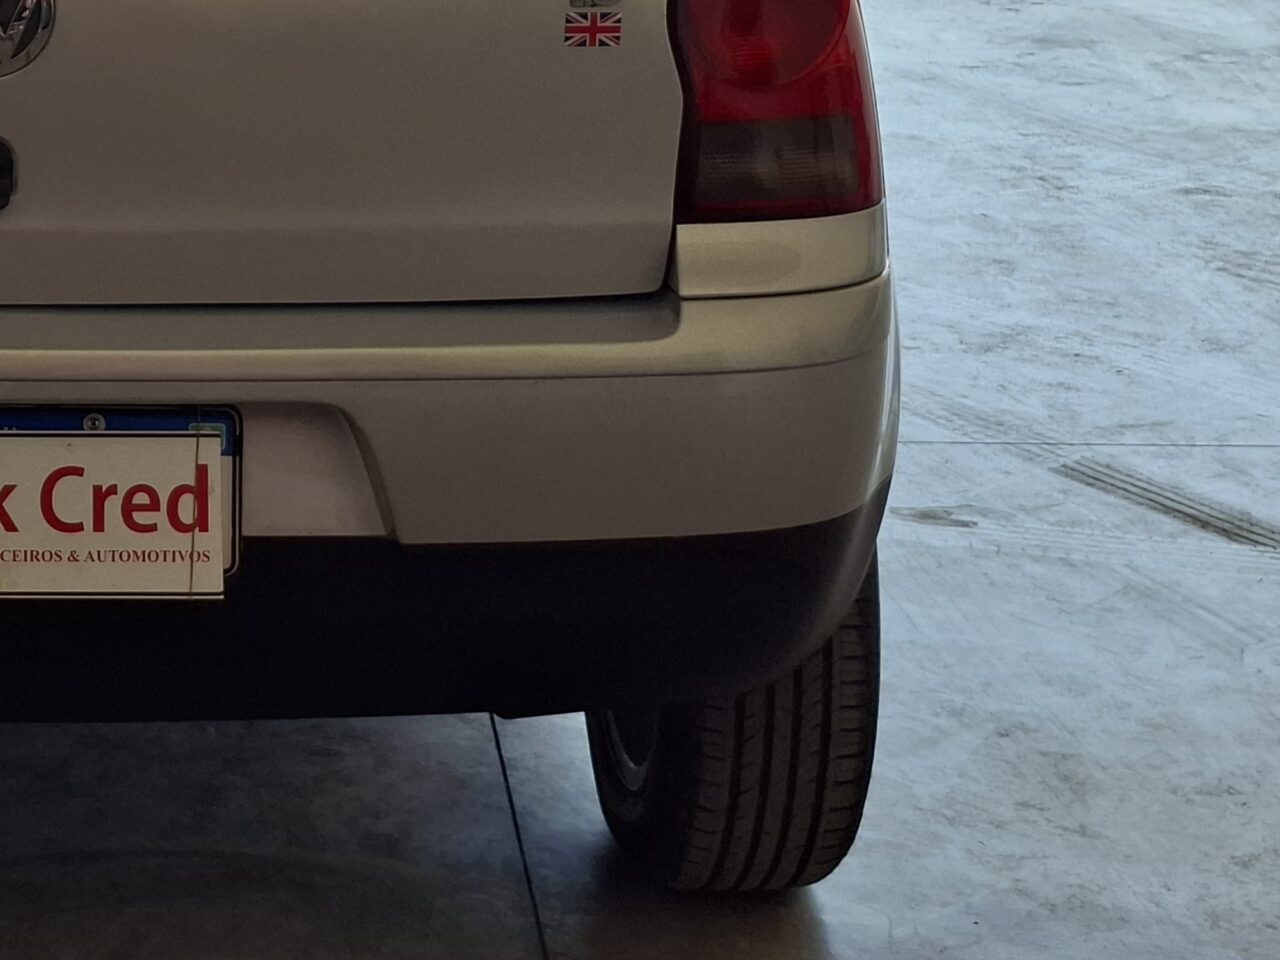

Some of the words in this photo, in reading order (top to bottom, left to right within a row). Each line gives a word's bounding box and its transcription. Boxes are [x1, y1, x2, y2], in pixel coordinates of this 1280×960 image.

[39, 463, 210, 533] Cred
[67, 549, 81, 563] &
[83, 549, 211, 563] AUTOMOTIVOS
